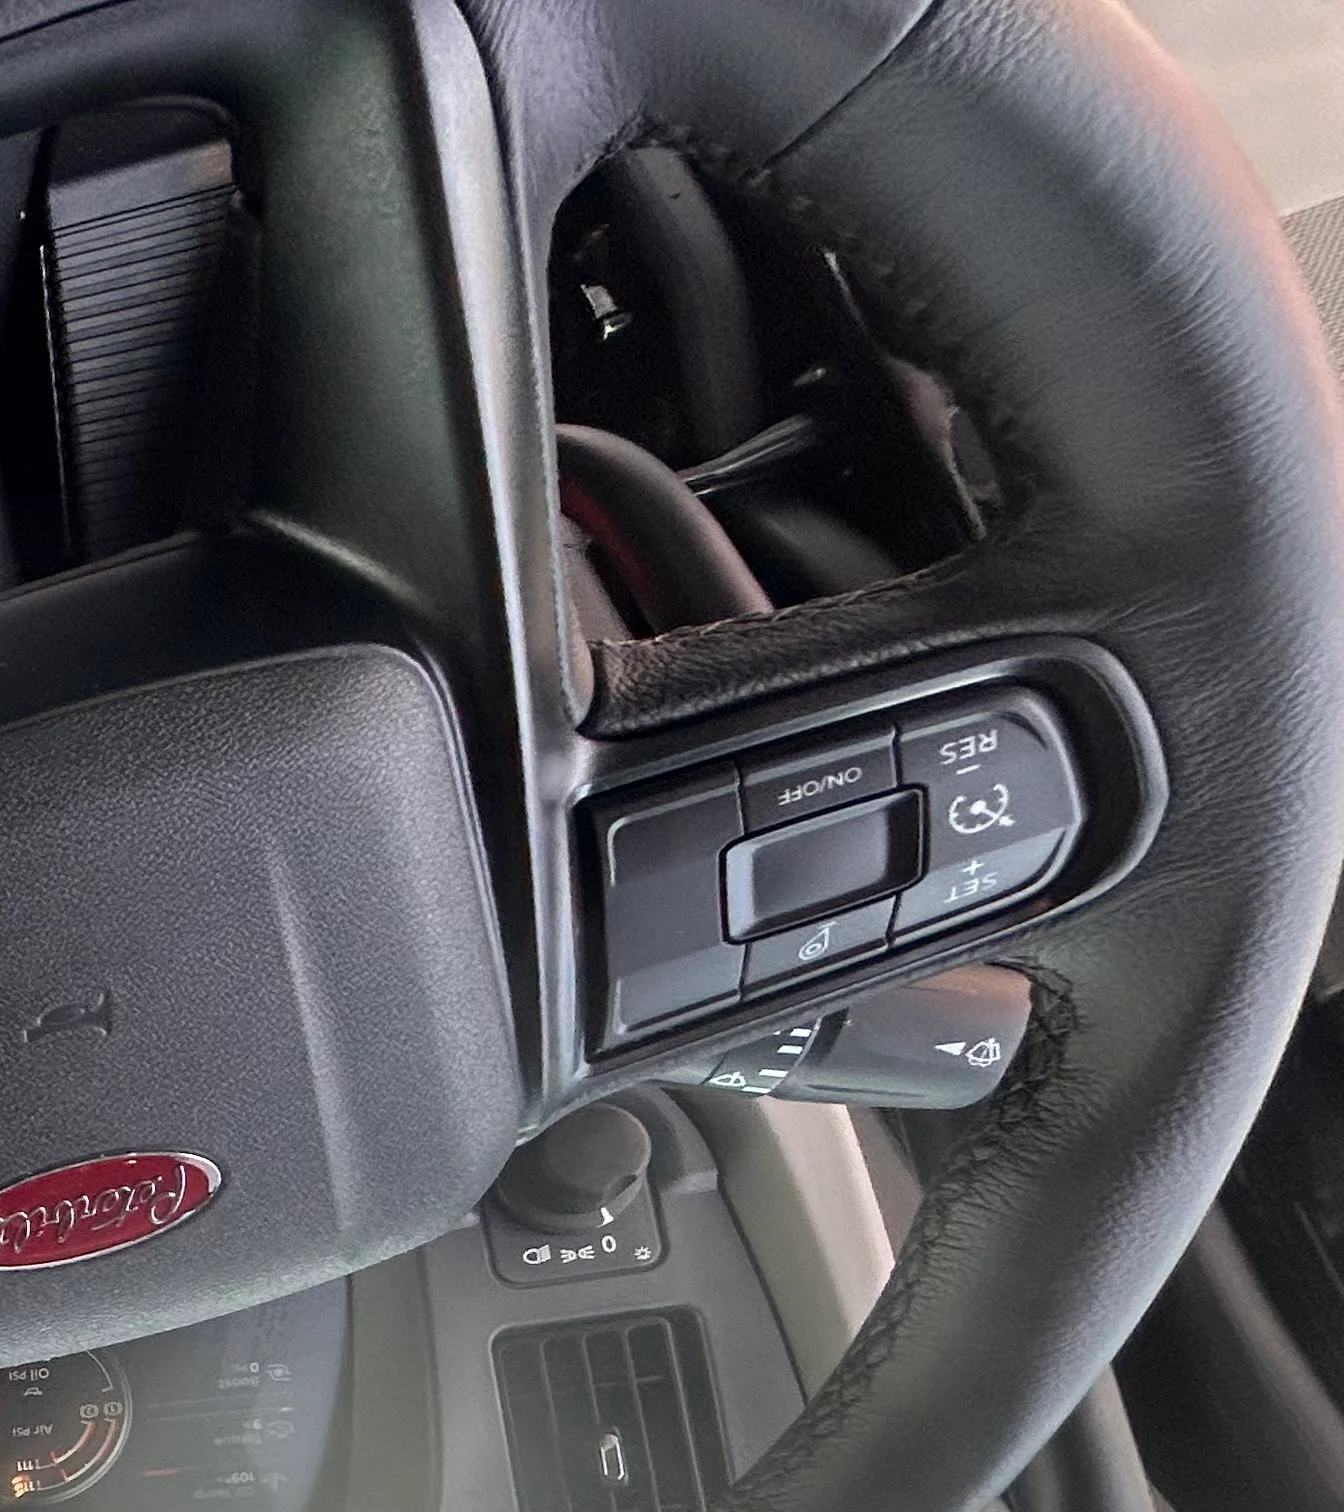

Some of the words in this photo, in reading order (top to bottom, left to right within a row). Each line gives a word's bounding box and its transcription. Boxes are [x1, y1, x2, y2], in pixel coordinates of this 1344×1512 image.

[938, 728, 999, 766] RES
[776, 765, 863, 807] ON/OFF
[943, 870, 999, 904] SET
[601, 1235, 617, 1254] 0
[8, 1369, 27, 1382] PSI
[29, 1367, 50, 1381] Oil
[33, 1424, 53, 1436] Air
